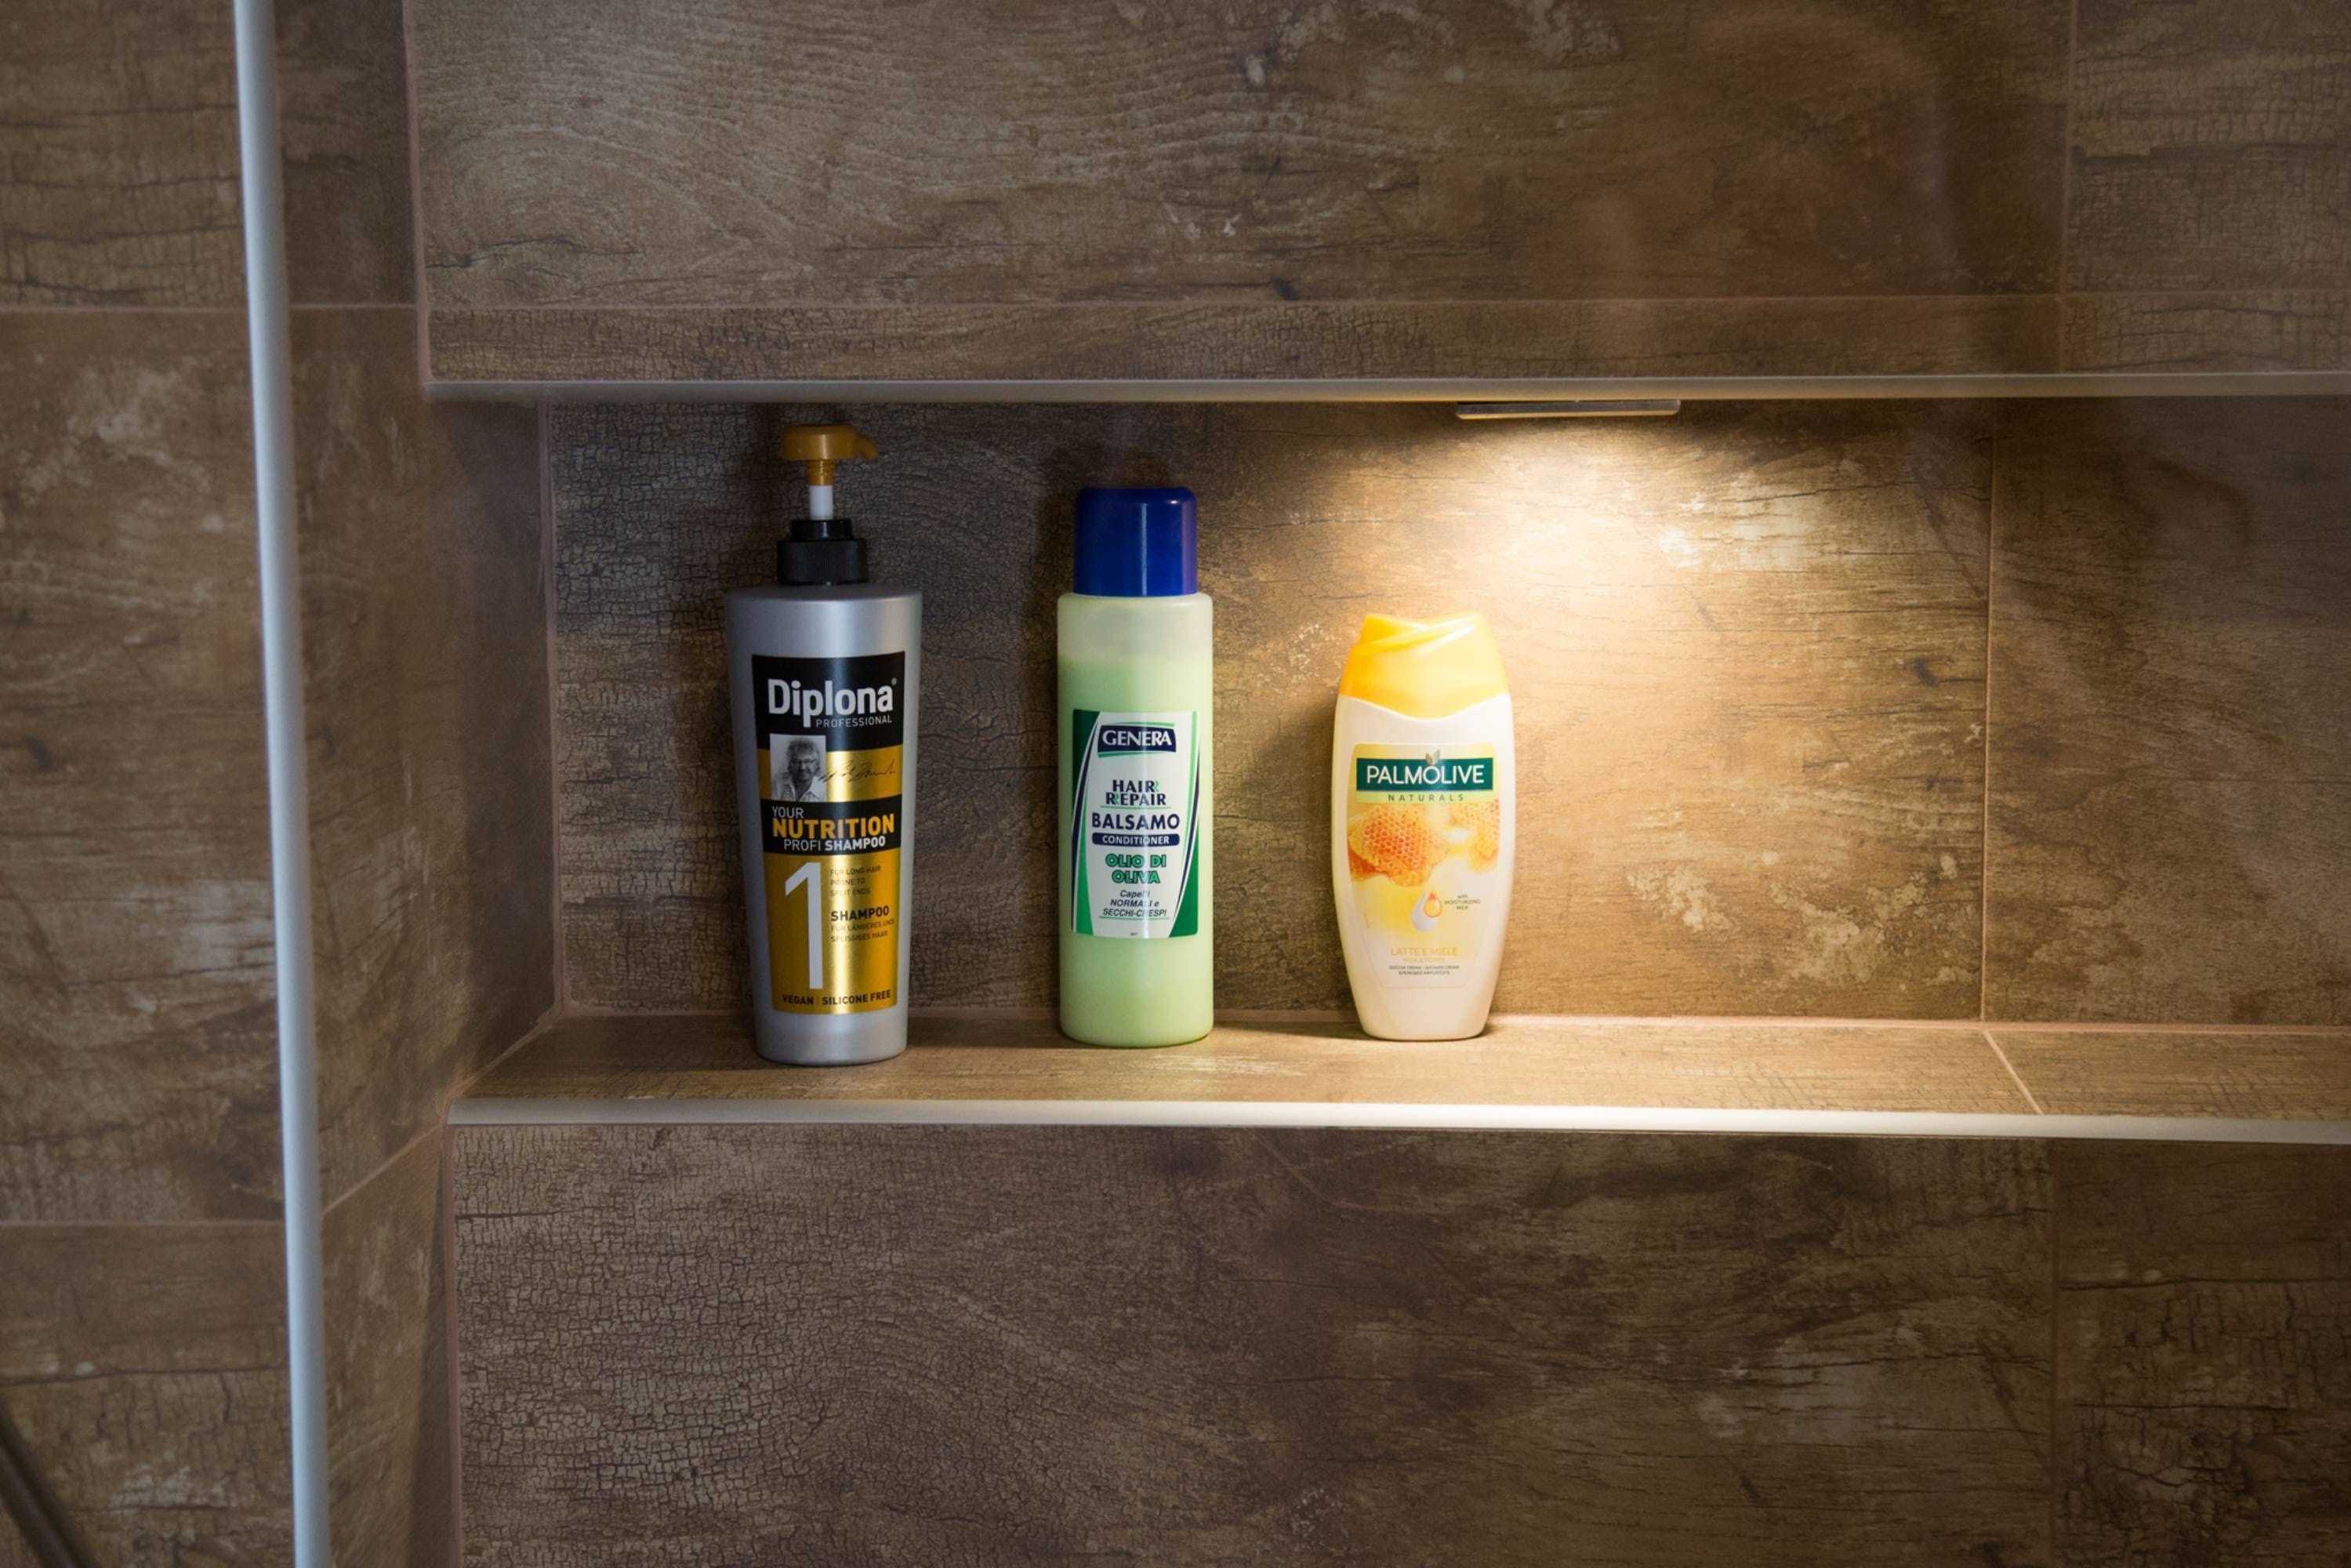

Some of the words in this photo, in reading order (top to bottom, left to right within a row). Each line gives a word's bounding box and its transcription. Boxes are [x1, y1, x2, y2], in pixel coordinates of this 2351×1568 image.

[816, 715, 892, 728] PROFESSIONAL
[1102, 730, 1172, 746] GENERA
[1366, 764, 1485, 785] PALMOLIVE
[1112, 779, 1155, 793] HAIR
[1105, 792, 1166, 806] REPAIR
[771, 806, 804, 818] YOUR
[772, 813, 894, 839] NUTRITION
[1092, 812, 1180, 830] BALSAMO
[784, 839, 821, 851] PROFI
[825, 836, 886, 851] SHAMPOO
[1102, 835, 1170, 845] CONDITIONER
[1105, 853, 1145, 868] OLIO
[1150, 855, 1166, 868] DI
[1112, 869, 1161, 884] OLIVA
[1110, 899, 1153, 908] NORMAI
[831, 906, 889, 921] SHAMPOO
[785, 862, 822, 989] 1
[782, 993, 814, 1005] VEGAN
[822, 993, 868, 1005] SILICONE
[870, 989, 891, 1001] FREE
